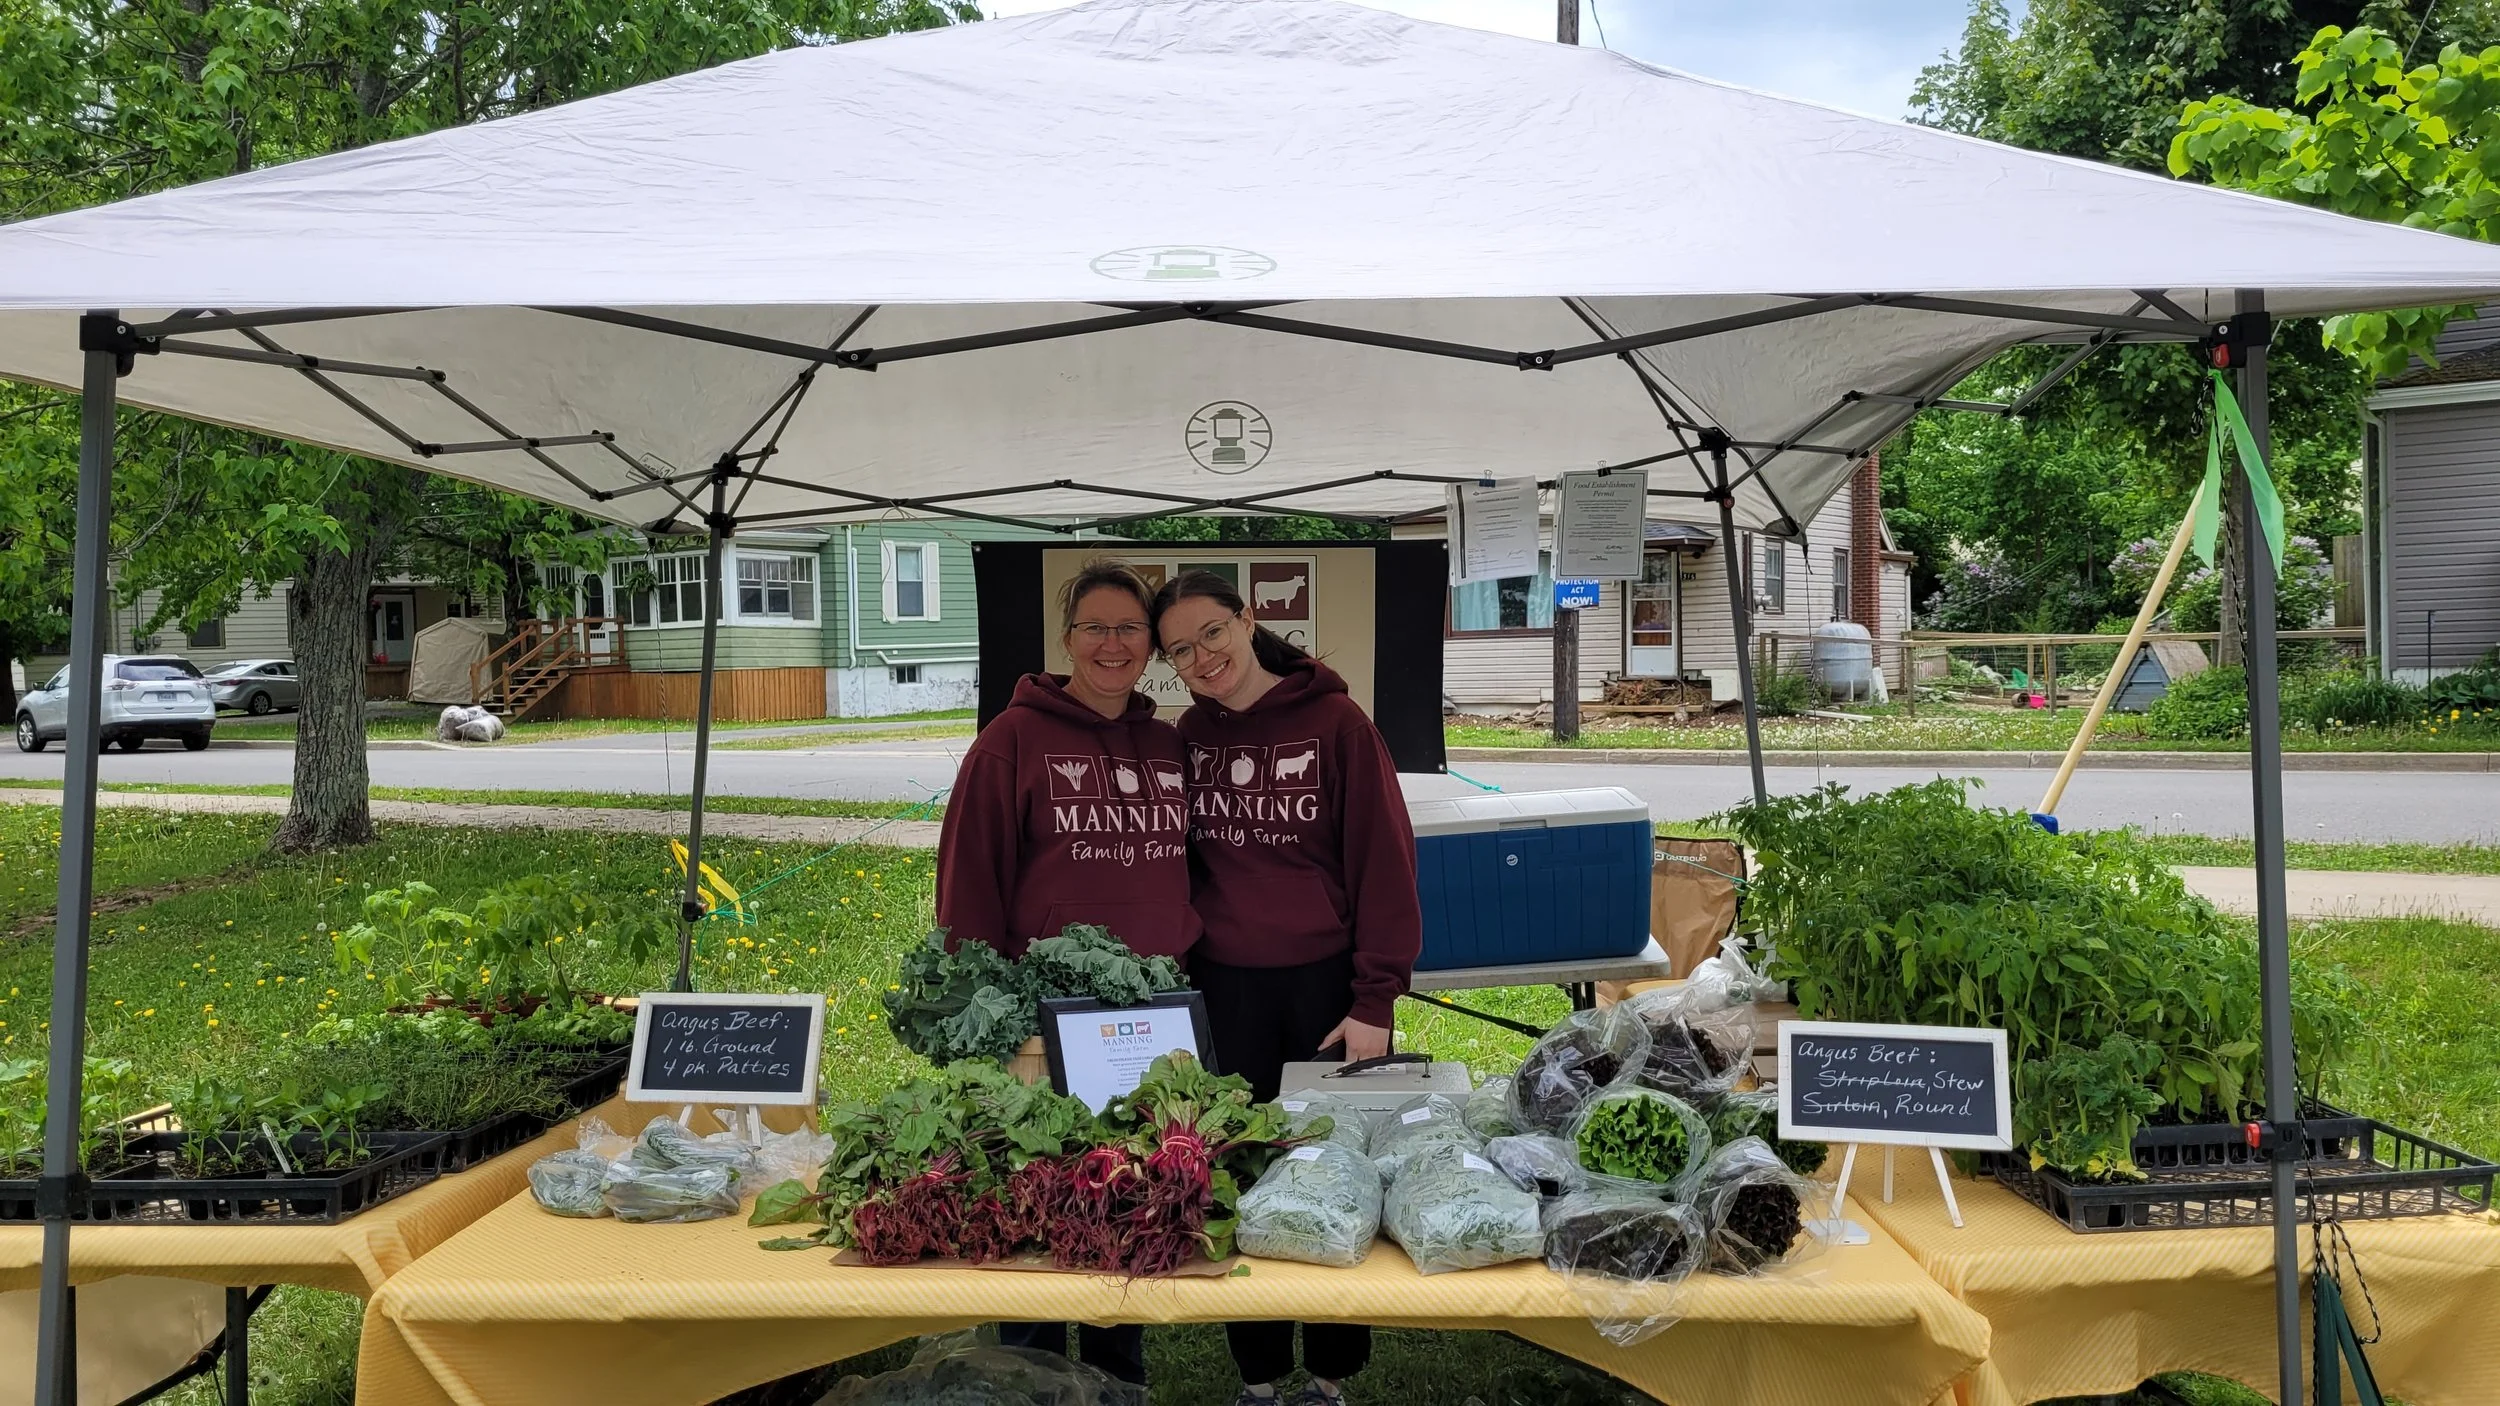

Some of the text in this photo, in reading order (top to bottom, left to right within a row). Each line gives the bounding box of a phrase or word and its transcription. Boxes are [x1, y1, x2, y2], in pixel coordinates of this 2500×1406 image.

[1573, 481, 1636, 489] Food Establishment
[1570, 586, 1584, 594] ACT
[1562, 596, 1593, 605] NOW!
[1188, 791, 1319, 822] ANNING
[1253, 828, 1300, 847] Farm
[1071, 840, 1135, 867] Family
[663, 1037, 674, 1054] 1
[703, 1034, 777, 1054] Ground
[1103, 1035, 1152, 1046] MANNING
[663, 1058, 678, 1078] 4
[717, 1056, 791, 1077] Patties
[1933, 1070, 1984, 1090] Stew
[1895, 1093, 1973, 1116] Round
